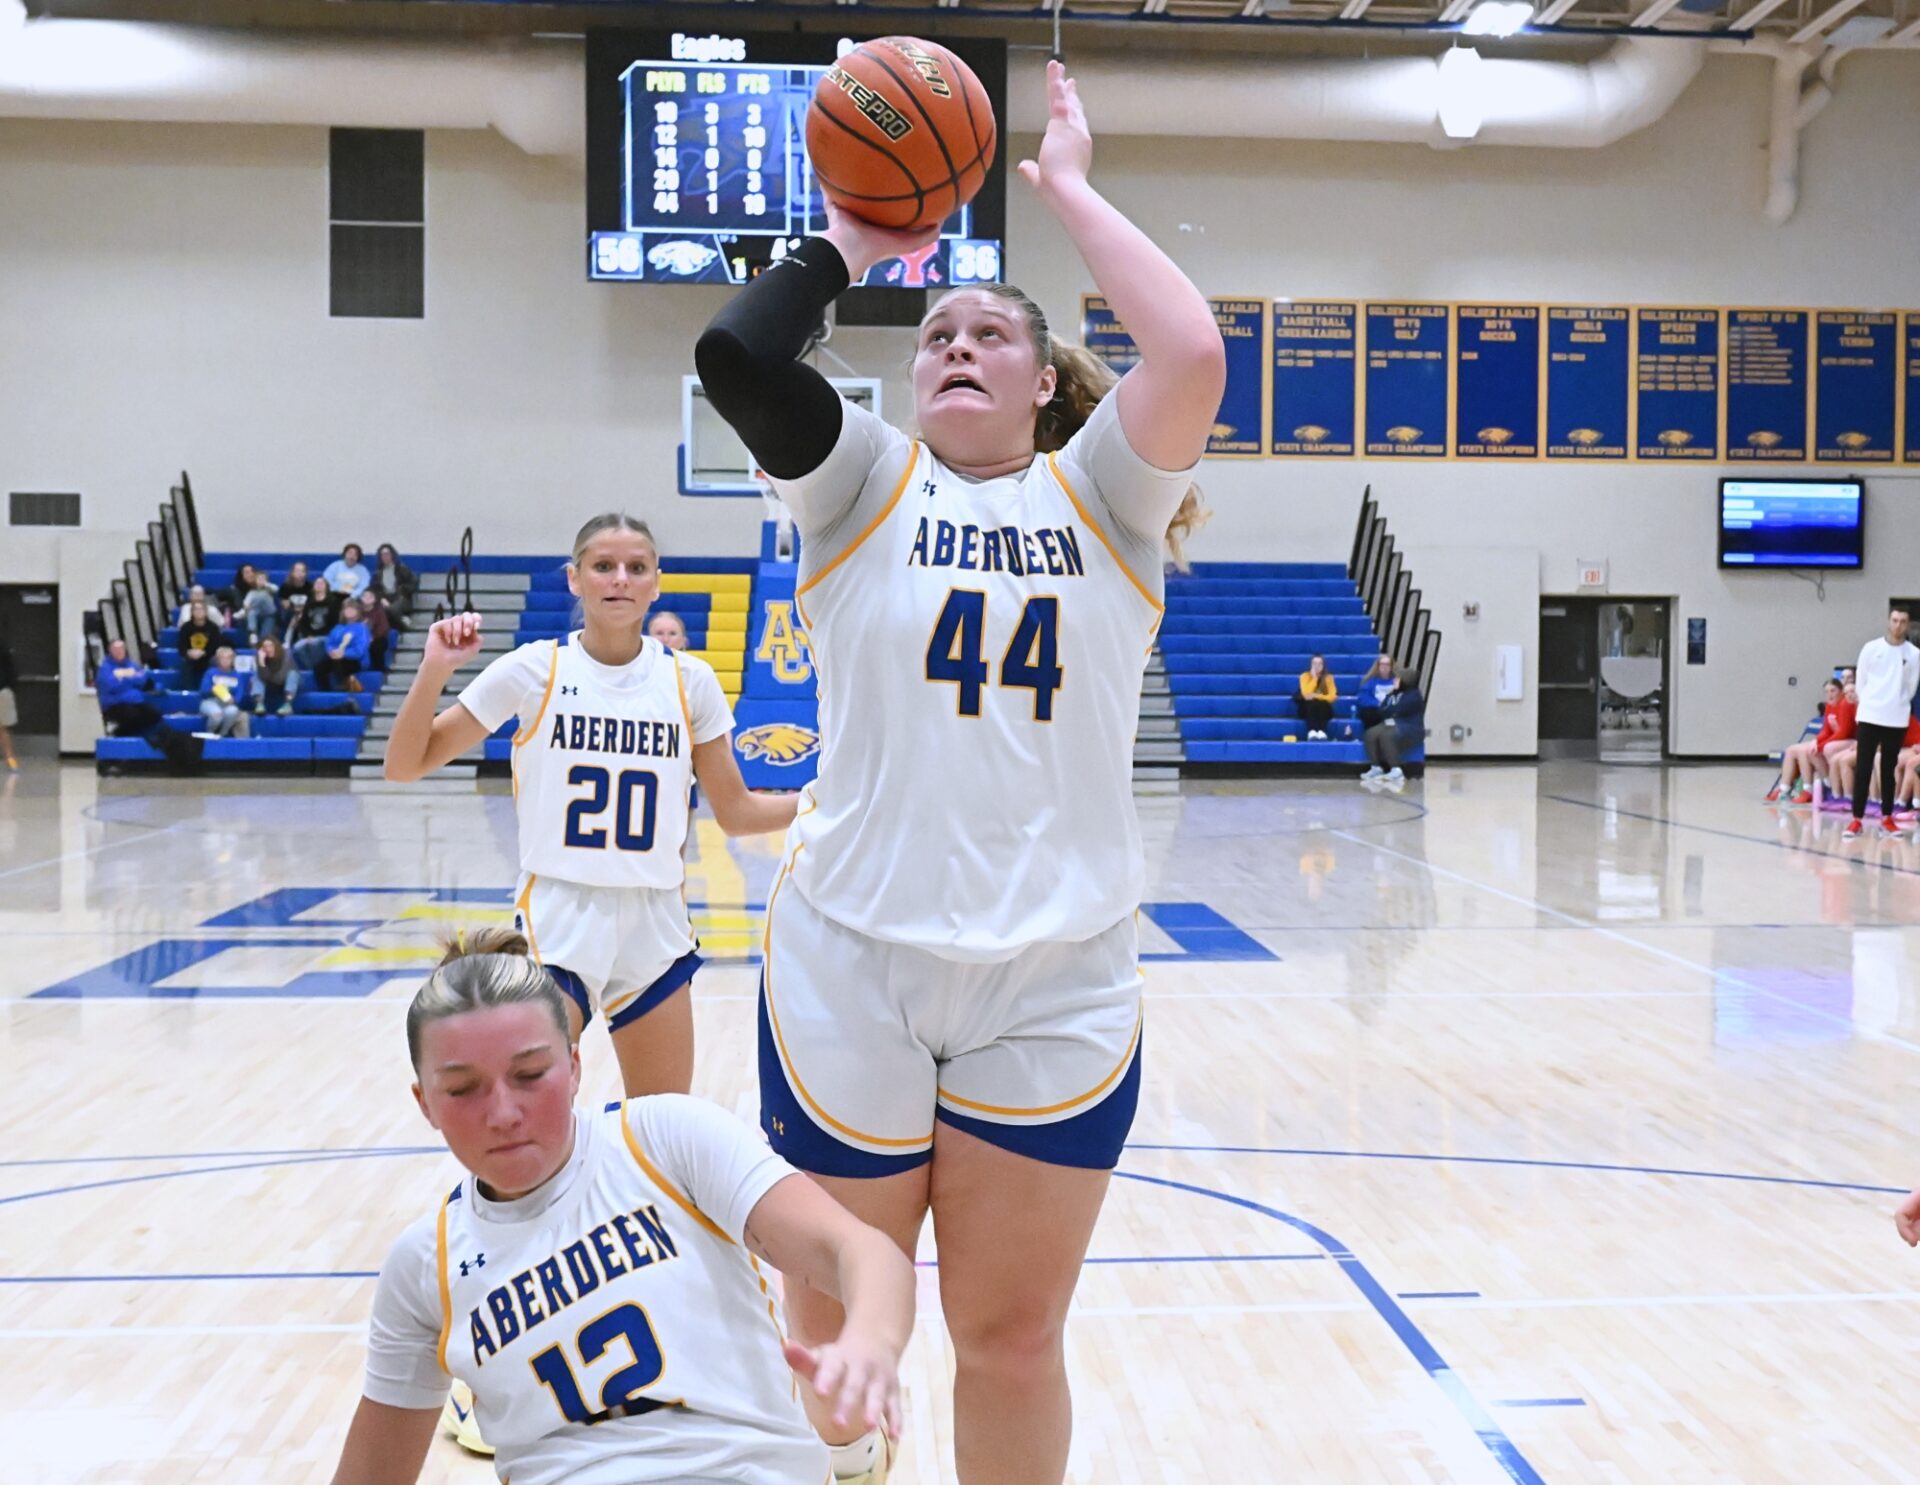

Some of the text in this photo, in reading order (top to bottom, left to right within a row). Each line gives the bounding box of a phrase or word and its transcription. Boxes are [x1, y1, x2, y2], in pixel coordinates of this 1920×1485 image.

[671, 33, 746, 62] Eagles
[737, 73, 770, 94] PTS
[705, 102, 719, 124] 3
[747, 104, 761, 125] 3
[654, 124, 677, 145] 12
[706, 125, 717, 146] 1
[653, 169, 761, 192] 20 1 3
[653, 191, 679, 213] 44
[706, 193, 717, 214] 1
[598, 237, 640, 272] 56
[956, 245, 997, 280] 36
[908, 516, 1085, 577] ABERDEEN
[925, 586, 1065, 723] 44
[550, 714, 680, 758] ABERDEEN
[564, 764, 659, 855] 20
[469, 1203, 680, 1368] ABERDEEN
[528, 1300, 687, 1425] 12
